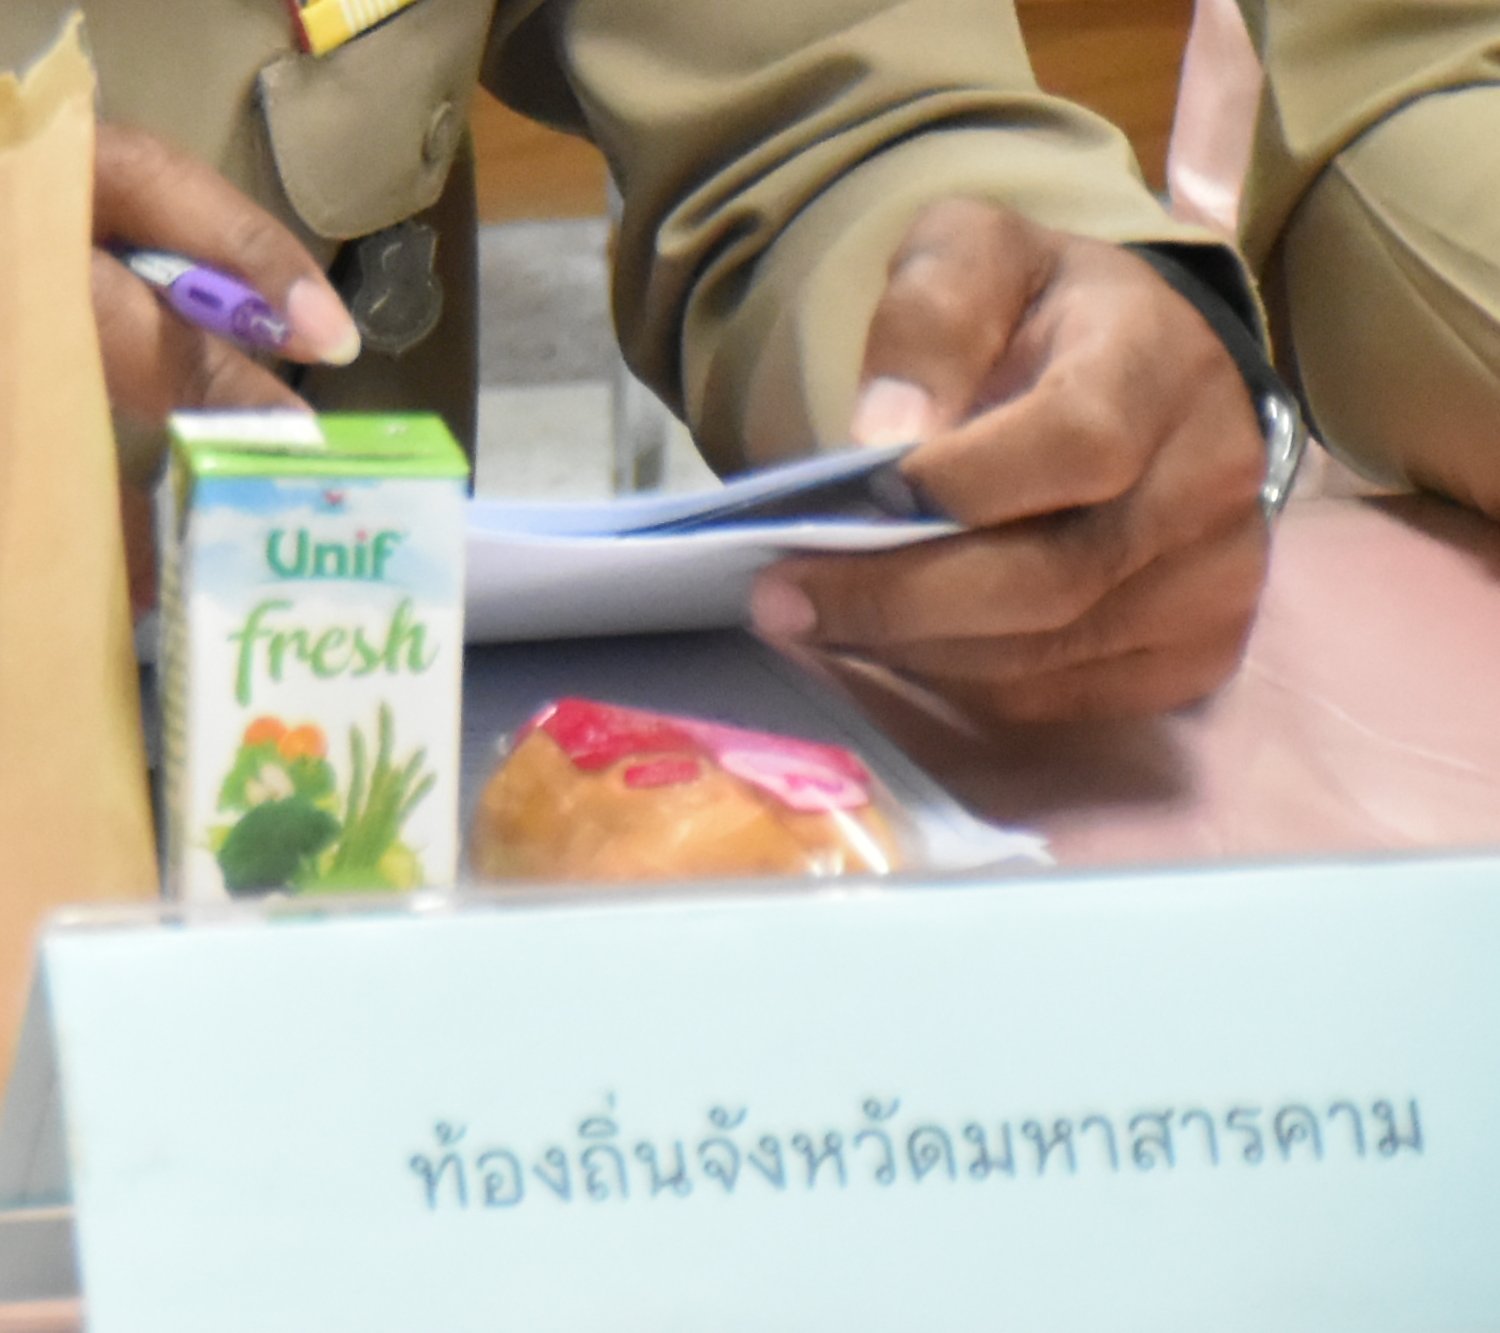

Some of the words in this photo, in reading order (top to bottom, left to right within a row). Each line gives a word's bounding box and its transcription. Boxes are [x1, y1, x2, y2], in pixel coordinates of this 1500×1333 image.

[265, 528, 404, 580] Unif
[228, 598, 436, 706] fresh
[408, 1090, 1426, 1212] ท้องถิ่นจังหวัดมหาสารคาม
